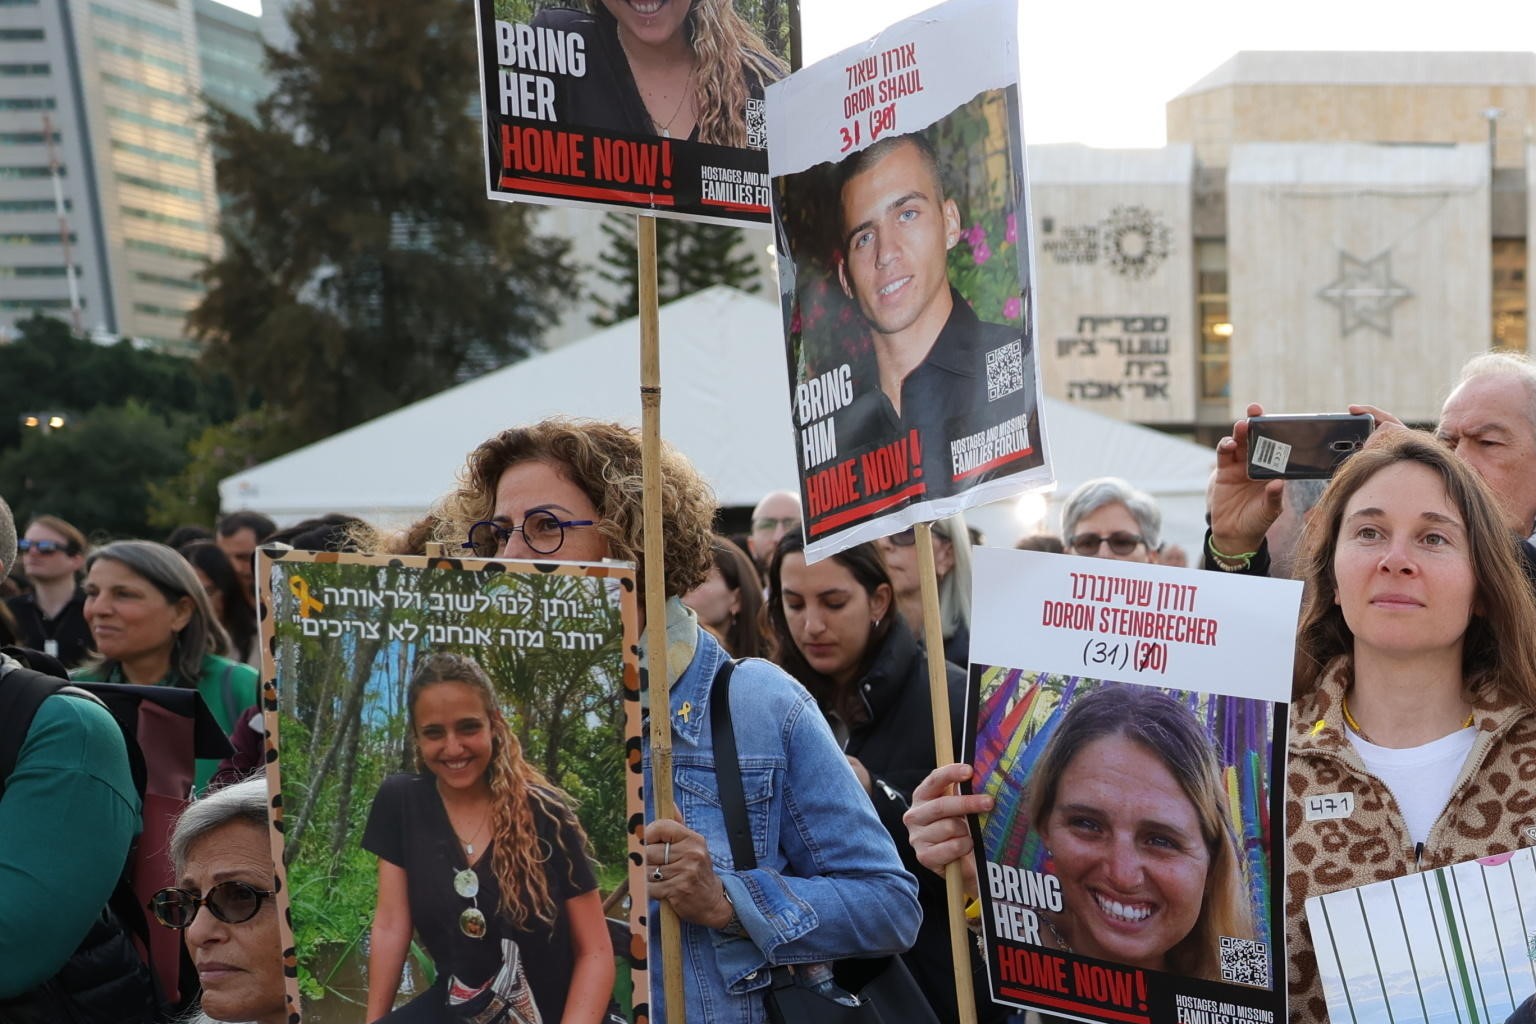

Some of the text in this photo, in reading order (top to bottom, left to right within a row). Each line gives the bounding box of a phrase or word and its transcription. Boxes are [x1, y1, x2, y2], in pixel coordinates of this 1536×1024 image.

[495, 20, 586, 77] BRING
[846, 42, 916, 90] אורון שאול
[499, 70, 557, 122] HER
[844, 69, 924, 119] ORON SHAUL
[501, 124, 674, 189] HOME NOW!
[701, 166, 742, 184] HOSTAGES
[743, 171, 759, 186] AND
[701, 180, 753, 205] FAMILIES
[797, 364, 853, 426] BRING
[802, 416, 837, 470] HIM
[951, 414, 1027, 455] HOSTAGES AND MISSING
[952, 429, 1030, 475] FAMILIES FORUM
[806, 429, 923, 518] HOME NOW!
[323, 586, 422, 610] ולראותה
[430, 591, 490, 613] לשוב
[499, 594, 533, 615] לנו
[1070, 573, 1198, 612] דורון שטיינברכר
[389, 619, 418, 641] לא
[427, 624, 493, 645] אנחנו
[501, 628, 544, 648] מזה
[552, 630, 603, 650] יותר
[1042, 600, 1218, 646] DORON STEINBRECHER
[1083, 638, 1129, 670] (31)
[1310, 797, 1348, 814] 471
[987, 861, 1063, 913] BRING
[991, 901, 1042, 946] HER
[997, 944, 1148, 1012] HOME NOW!
[1175, 994, 1274, 1023] HOSTAGES AND MISSING
